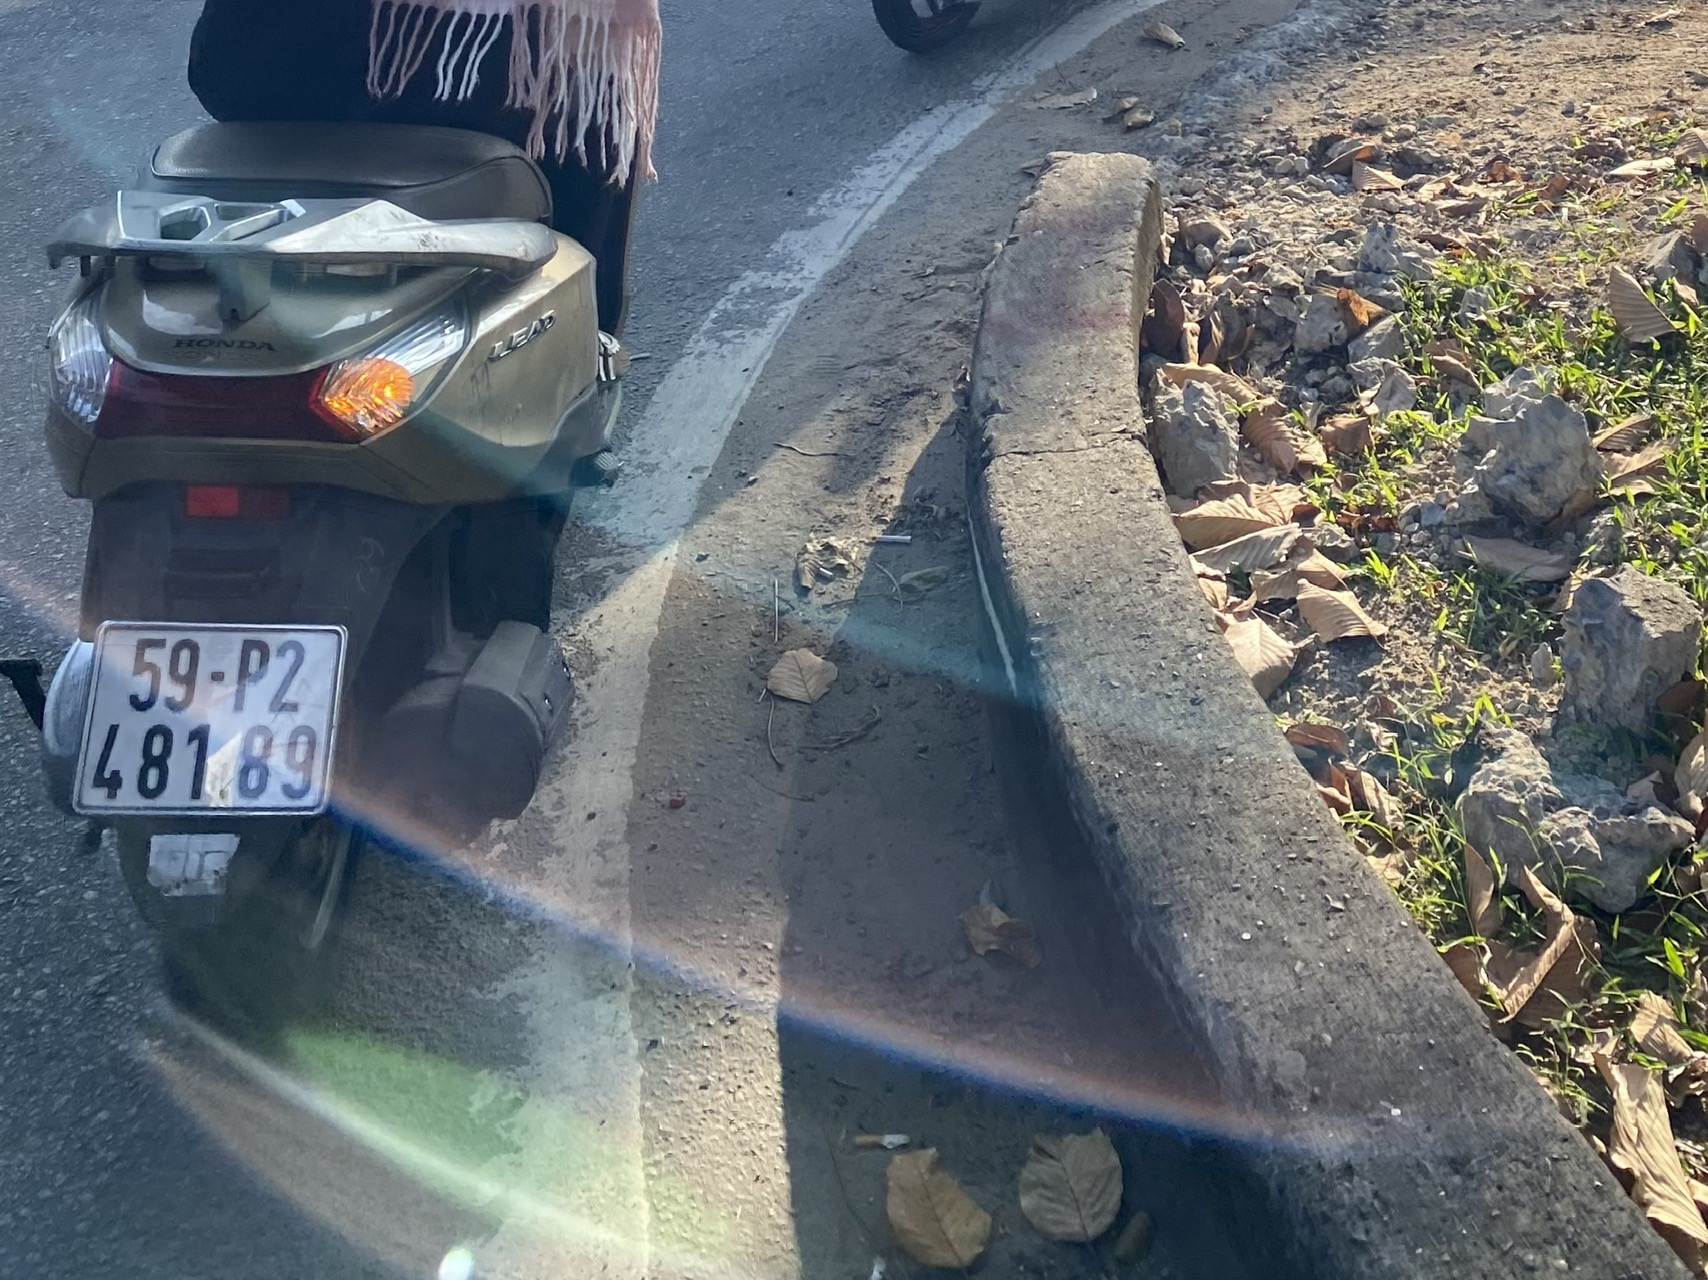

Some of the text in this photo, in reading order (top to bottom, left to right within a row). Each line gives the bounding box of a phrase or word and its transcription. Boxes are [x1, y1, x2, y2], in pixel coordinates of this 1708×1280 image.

[172, 338, 275, 352] HONDA
[487, 309, 557, 362] LEAD
[129, 637, 306, 713] 59-P2
